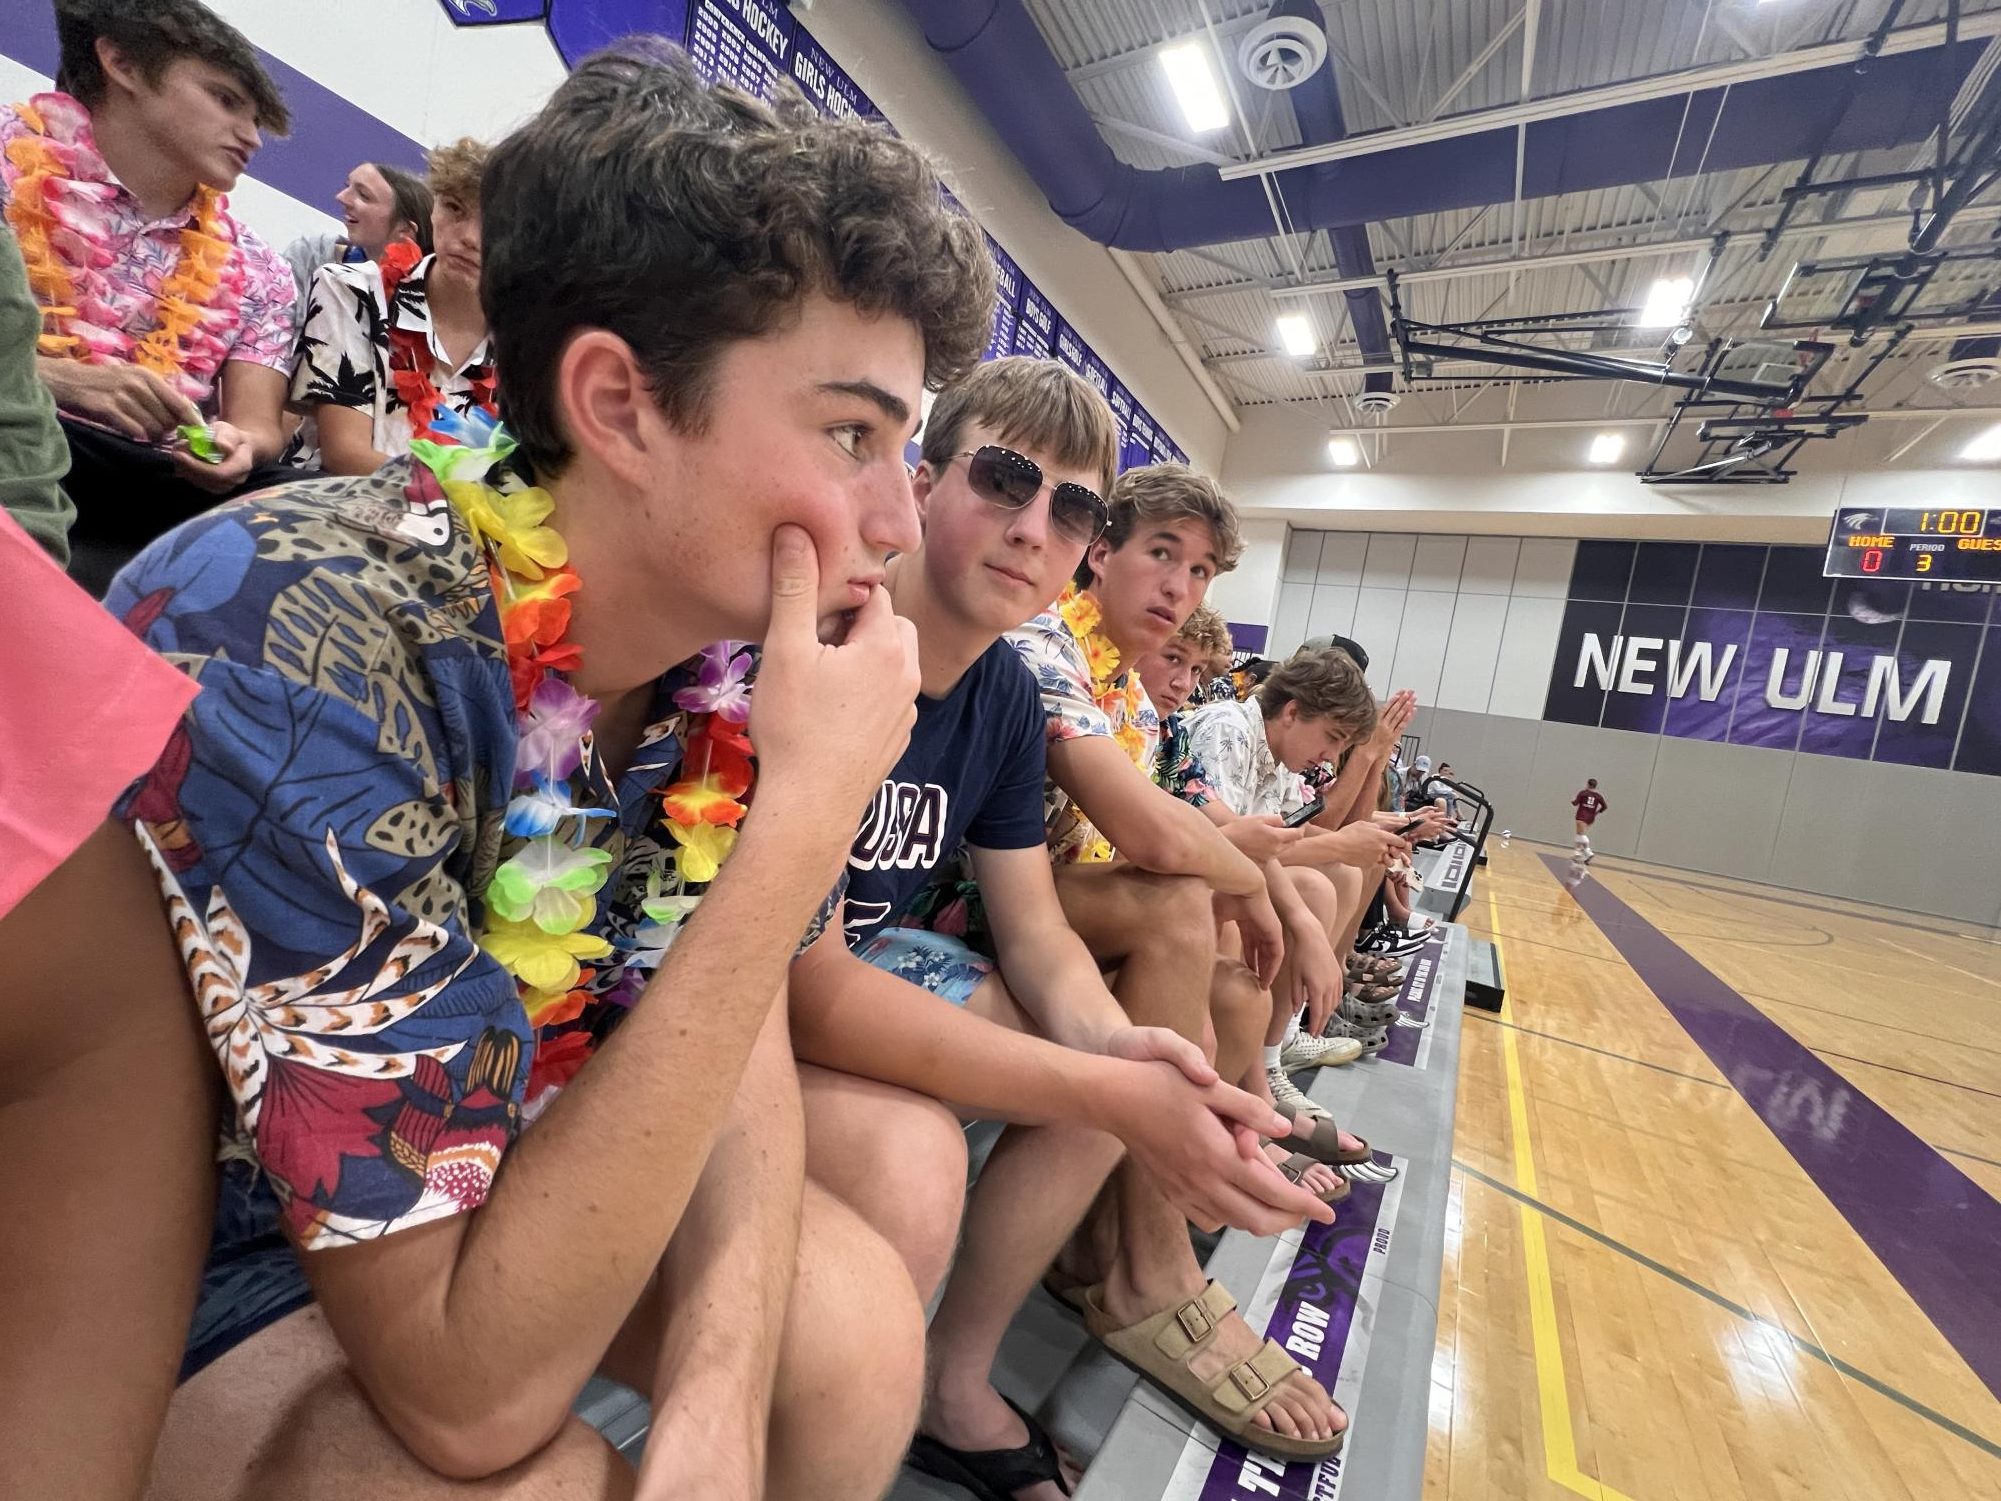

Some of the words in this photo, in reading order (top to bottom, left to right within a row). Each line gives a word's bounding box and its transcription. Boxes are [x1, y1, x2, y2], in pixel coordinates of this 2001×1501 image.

[742, 0, 788, 60] HOCKEY
[794, 52, 826, 99] GIRLS
[826, 84, 861, 121] HOCK
[811, 47, 835, 78] NEW
[837, 76, 858, 105] ULM
[1920, 511, 1981, 534] 1:00
[1849, 536, 1896, 548] HOME
[1909, 543, 1945, 552] PERIOD
[1862, 550, 1883, 573] 0
[1916, 554, 1932, 572] 3
[1573, 632, 1738, 702] NEW
[1764, 647, 1952, 725] ULM
[1373, 1227, 1391, 1255] PROUD
[1286, 1300, 1331, 1361] ROW
